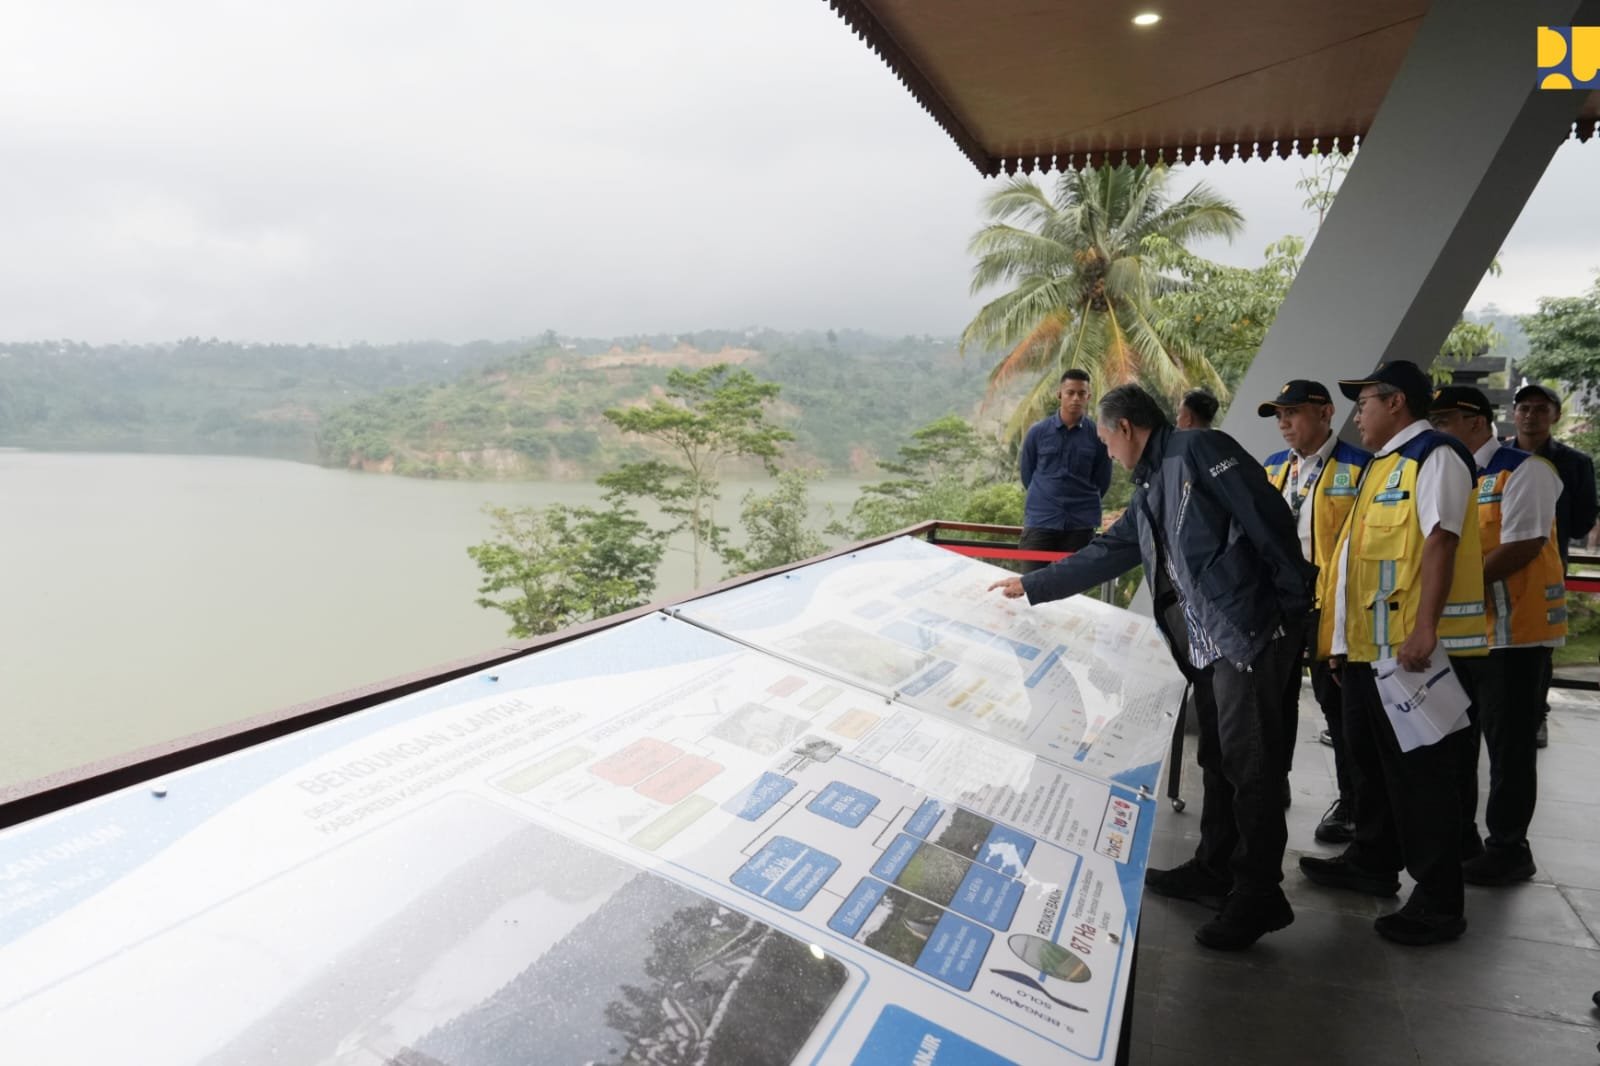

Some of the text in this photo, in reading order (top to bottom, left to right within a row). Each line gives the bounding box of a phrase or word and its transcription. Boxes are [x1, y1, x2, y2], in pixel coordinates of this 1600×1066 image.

[296, 730, 452, 795] BENDUNGAN
[446, 698, 533, 737] JLANTAH
[314, 794, 399, 834] KABUPATEN
[1071, 923, 1096, 955] 87 Ha
[990, 989, 1061, 1027] BENGAWAN
[1016, 989, 1052, 1010] SOLO
